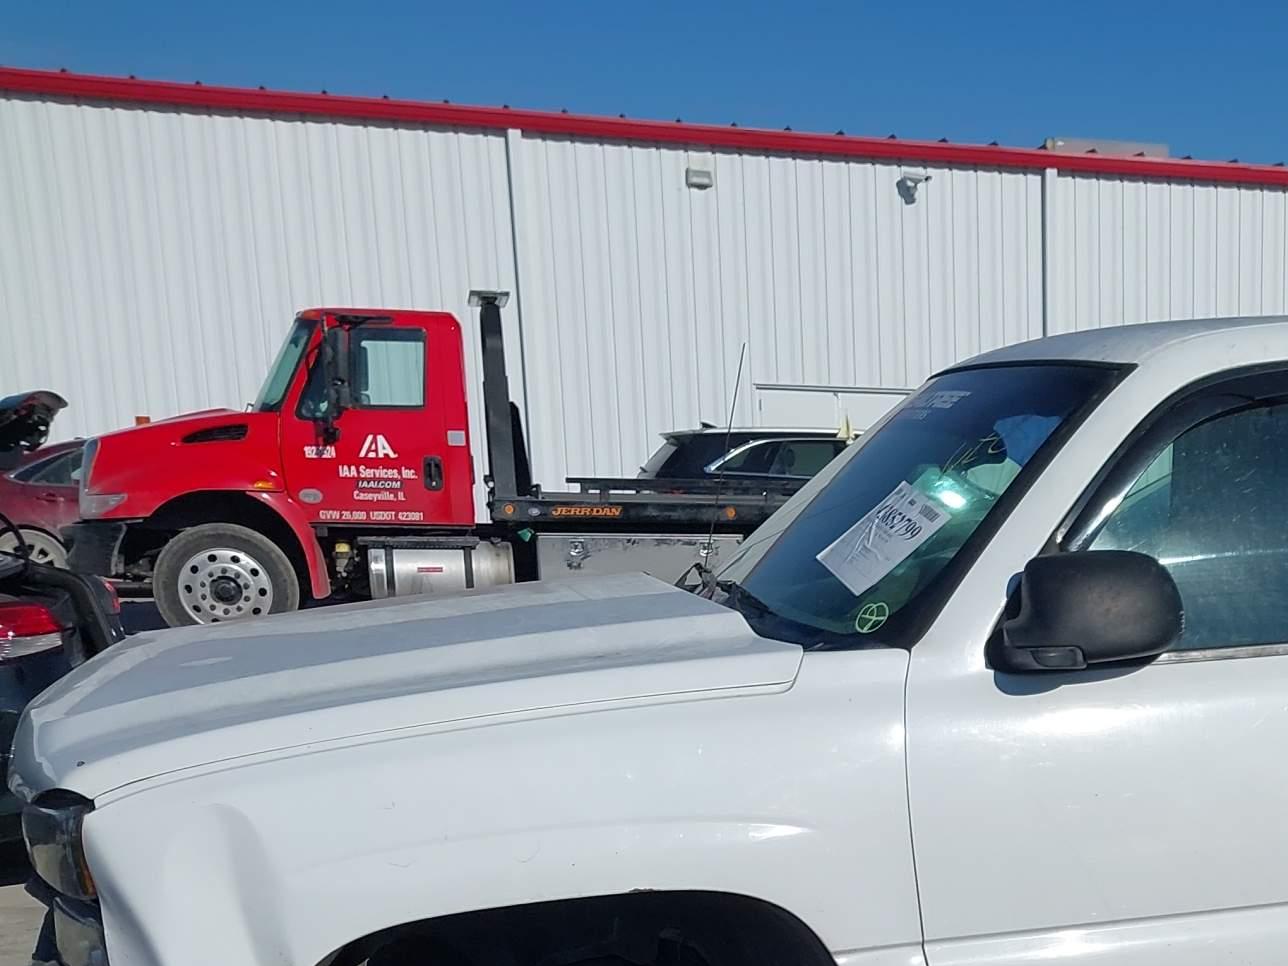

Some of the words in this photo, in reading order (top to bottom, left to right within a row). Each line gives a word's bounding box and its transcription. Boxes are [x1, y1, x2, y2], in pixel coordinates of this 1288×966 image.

[338, 465, 357, 477] IAA
[359, 466, 400, 479] Services,
[401, 466, 418, 479] Inc.
[353, 491, 397, 501] Caseyville,
[319, 510, 340, 520] GVW
